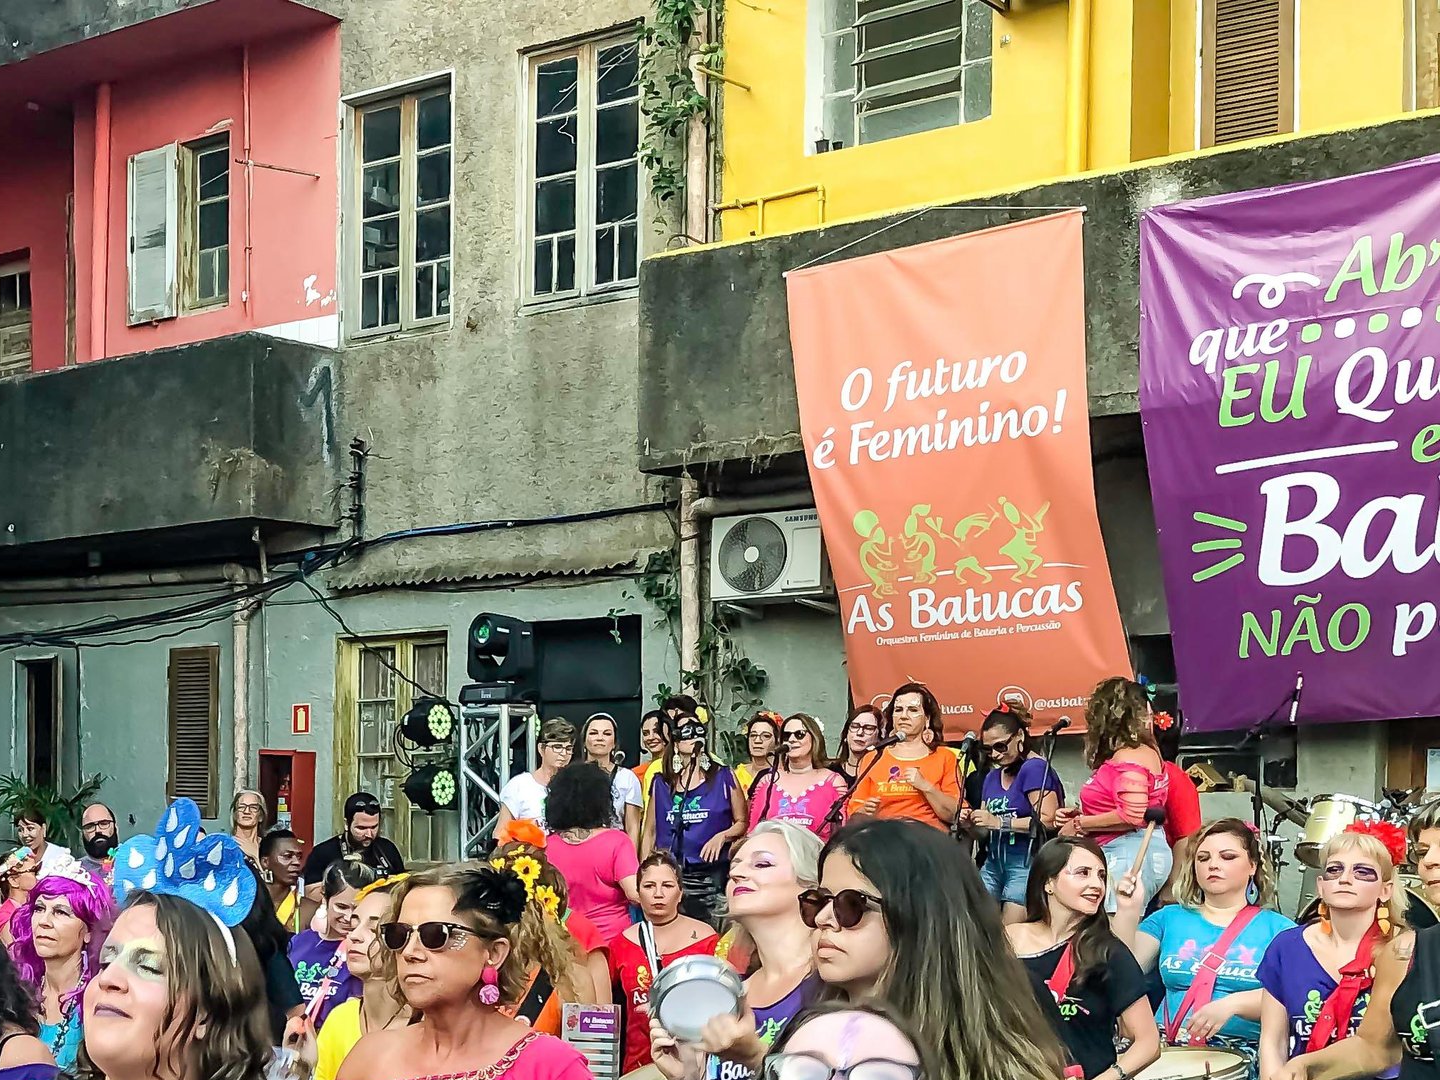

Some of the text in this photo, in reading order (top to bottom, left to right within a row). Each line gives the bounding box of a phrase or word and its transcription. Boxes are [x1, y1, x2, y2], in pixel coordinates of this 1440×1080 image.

[1188, 319, 1290, 374] que
[840, 350, 1028, 412] O futuro
[1218, 355, 1313, 428] EU
[812, 389, 1068, 469] é Feminino!
[784, 514, 818, 522] SAMSUNG
[1258, 471, 1440, 586] Ba
[847, 581, 1083, 634] As Batucas
[876, 620, 1062, 647] Orquestra Feminina de Bateria e Percussão
[1238, 592, 1440, 659] NÃO p
[941, 696, 1088, 715] tucas @asbat
[633, 991, 648, 1004] As
